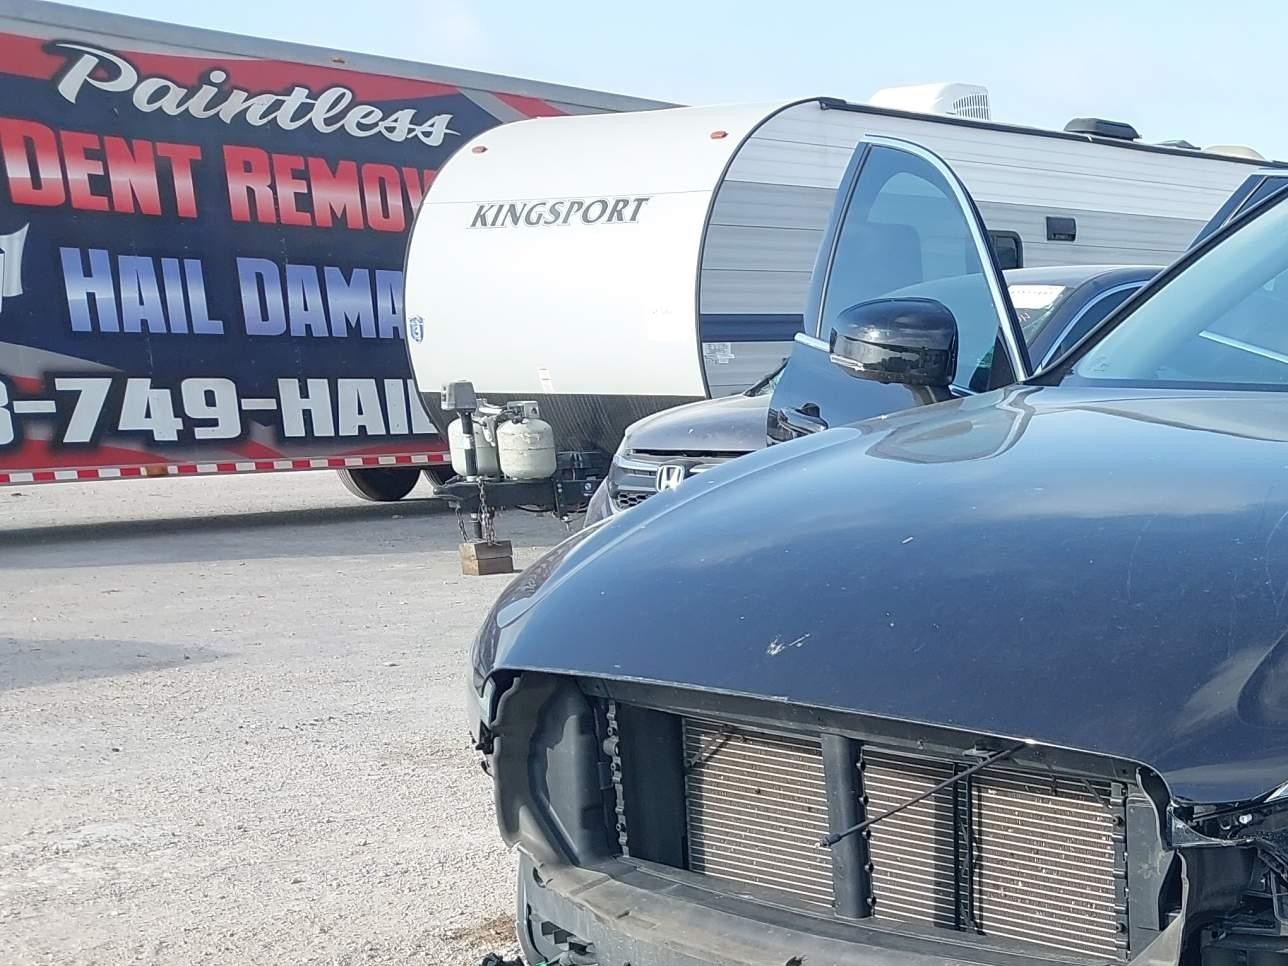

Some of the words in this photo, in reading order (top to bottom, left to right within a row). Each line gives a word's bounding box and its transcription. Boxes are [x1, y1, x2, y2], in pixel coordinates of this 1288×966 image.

[55, 43, 460, 147] Paintless
[2, 118, 201, 219] DENT
[469, 197, 650, 229] KINGSPORT
[59, 247, 223, 334] HAIL
[0, 377, 440, 446] -749-HAIL
